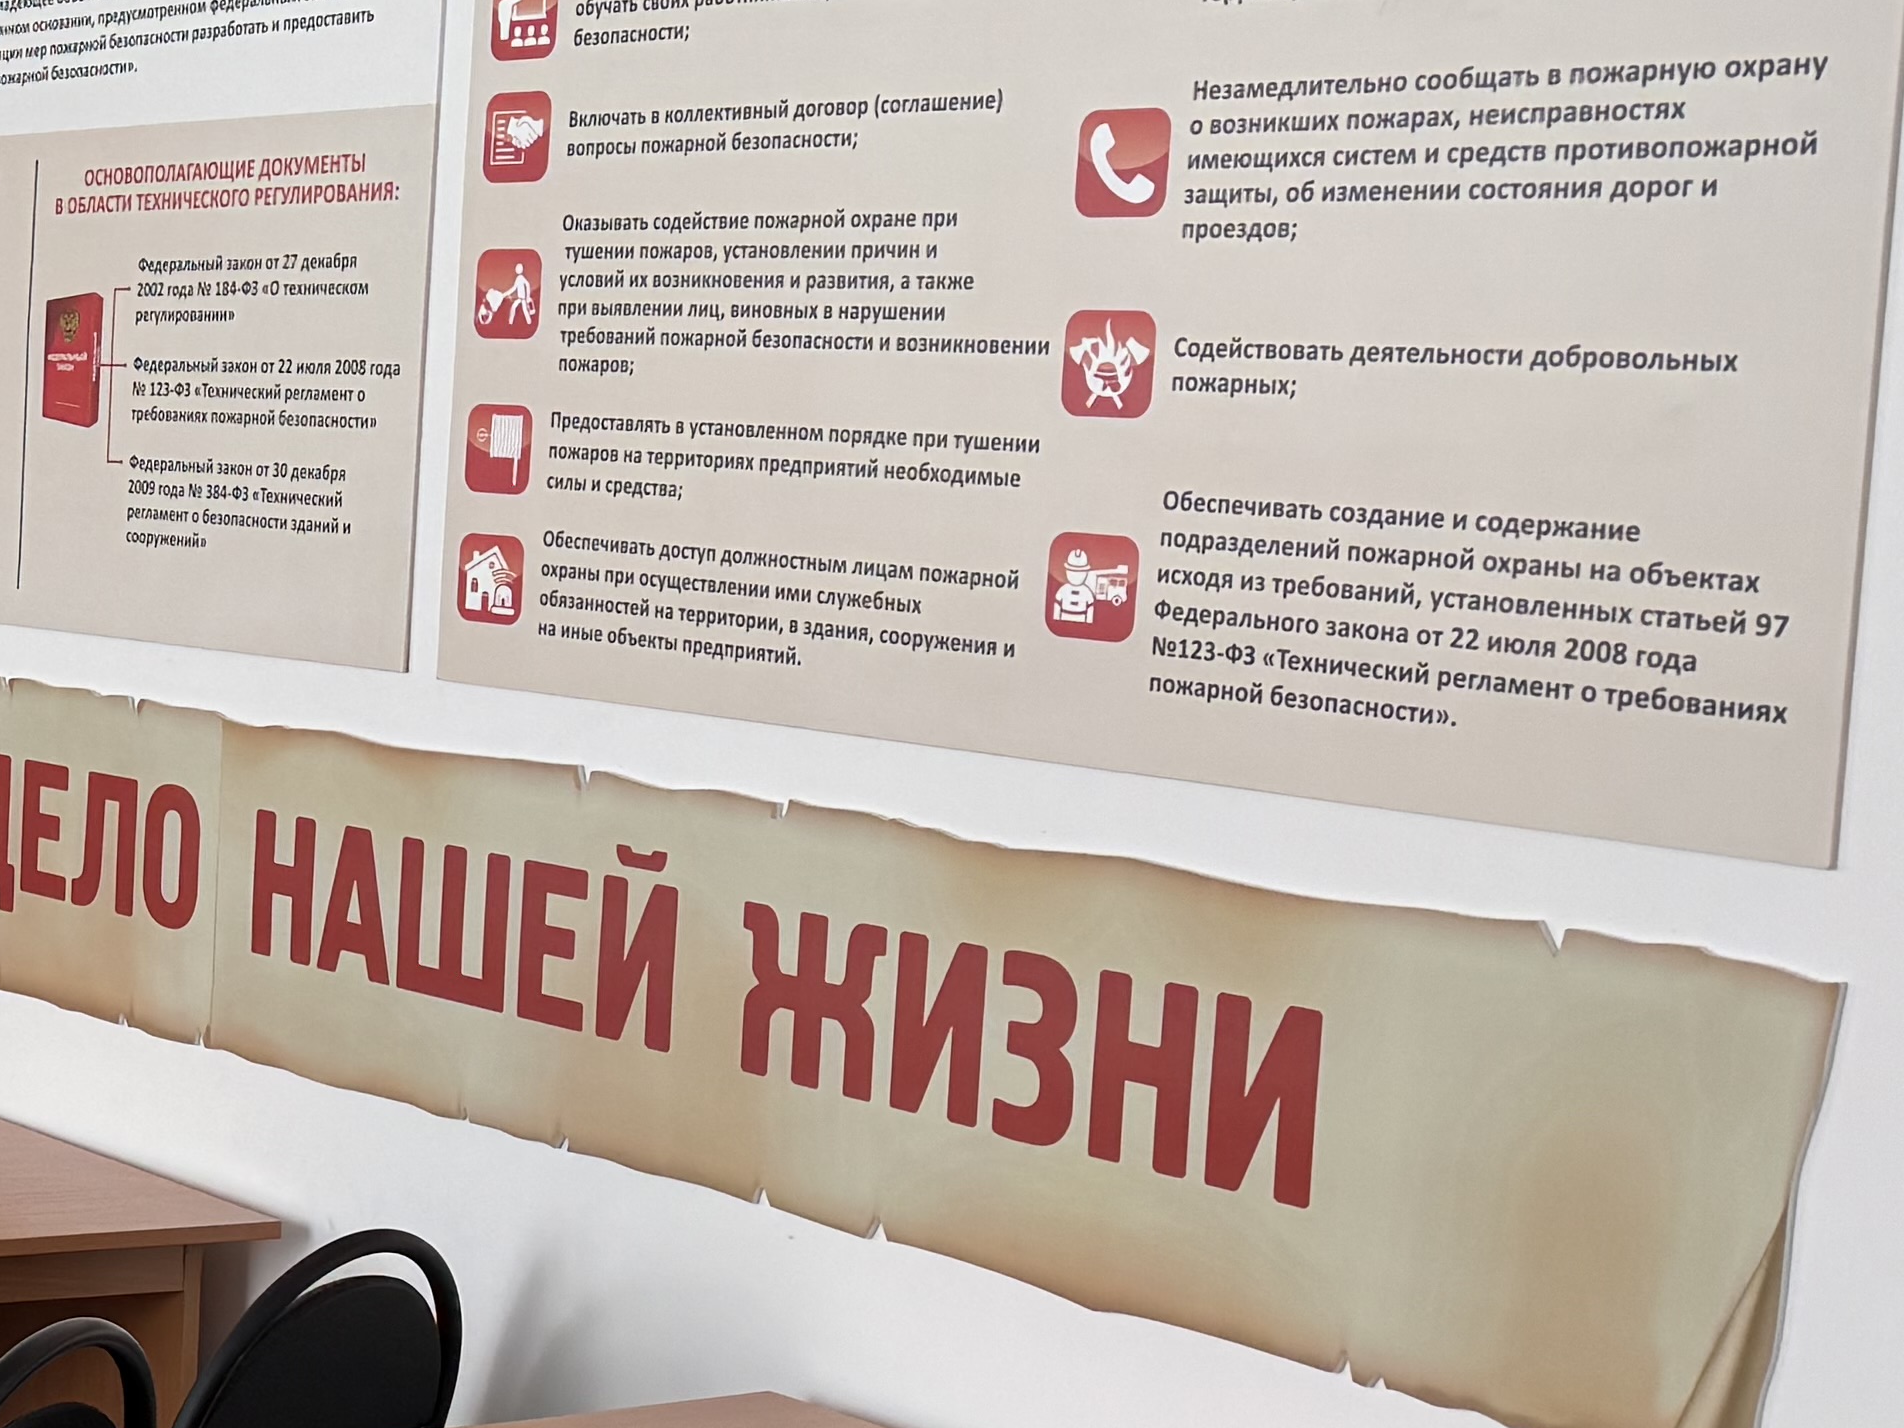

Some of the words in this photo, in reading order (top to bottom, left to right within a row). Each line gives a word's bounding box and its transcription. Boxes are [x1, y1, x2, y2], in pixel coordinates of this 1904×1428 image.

[569, 111, 646, 128] Включать
[651, 111, 660, 124] в
[665, 99, 789, 124] коллективный
[793, 101, 869, 122] договор
[875, 88, 1003, 119] (соглашение)
[567, 141, 637, 160] вопросы
[641, 132, 726, 157] пожарной
[732, 132, 858, 151] безопасности;
[85, 159, 256, 187] ОСНОВОПОЛАГАЮЩИЕ
[258, 153, 366, 182] ДОКУМЕНТЫ
[56, 198, 64, 216] В
[68, 194, 132, 215] ОБЛАСТИ
[136, 189, 250, 211] ТЕХНИЧЕСКОГО
[255, 181, 400, 206] РЕГУЛИРОВАНИЯ:
[138, 255, 223, 275] Федеральный
[227, 259, 263, 271] закон
[266, 258, 280, 270] от
[282, 254, 298, 270] 27
[301, 252, 357, 272] декабря
[137, 282, 164, 298] 2002
[168, 285, 194, 300] года
[197, 282, 212, 297] №
[216, 281, 259, 297] 184-ФЗ
[262, 281, 280, 296] «О
[283, 283, 369, 296] техническом
[135, 310, 235, 326] регулировании»
[1175, 337, 1344, 363] Содействовать
[1349, 346, 1523, 367] деятельности
[1529, 344, 1738, 374] добровольных
[1172, 376, 1297, 400] пожарных;
[251, 809, 678, 1053] НАШЕЙ
[741, 902, 1320, 1209] ЖИЗНИ
